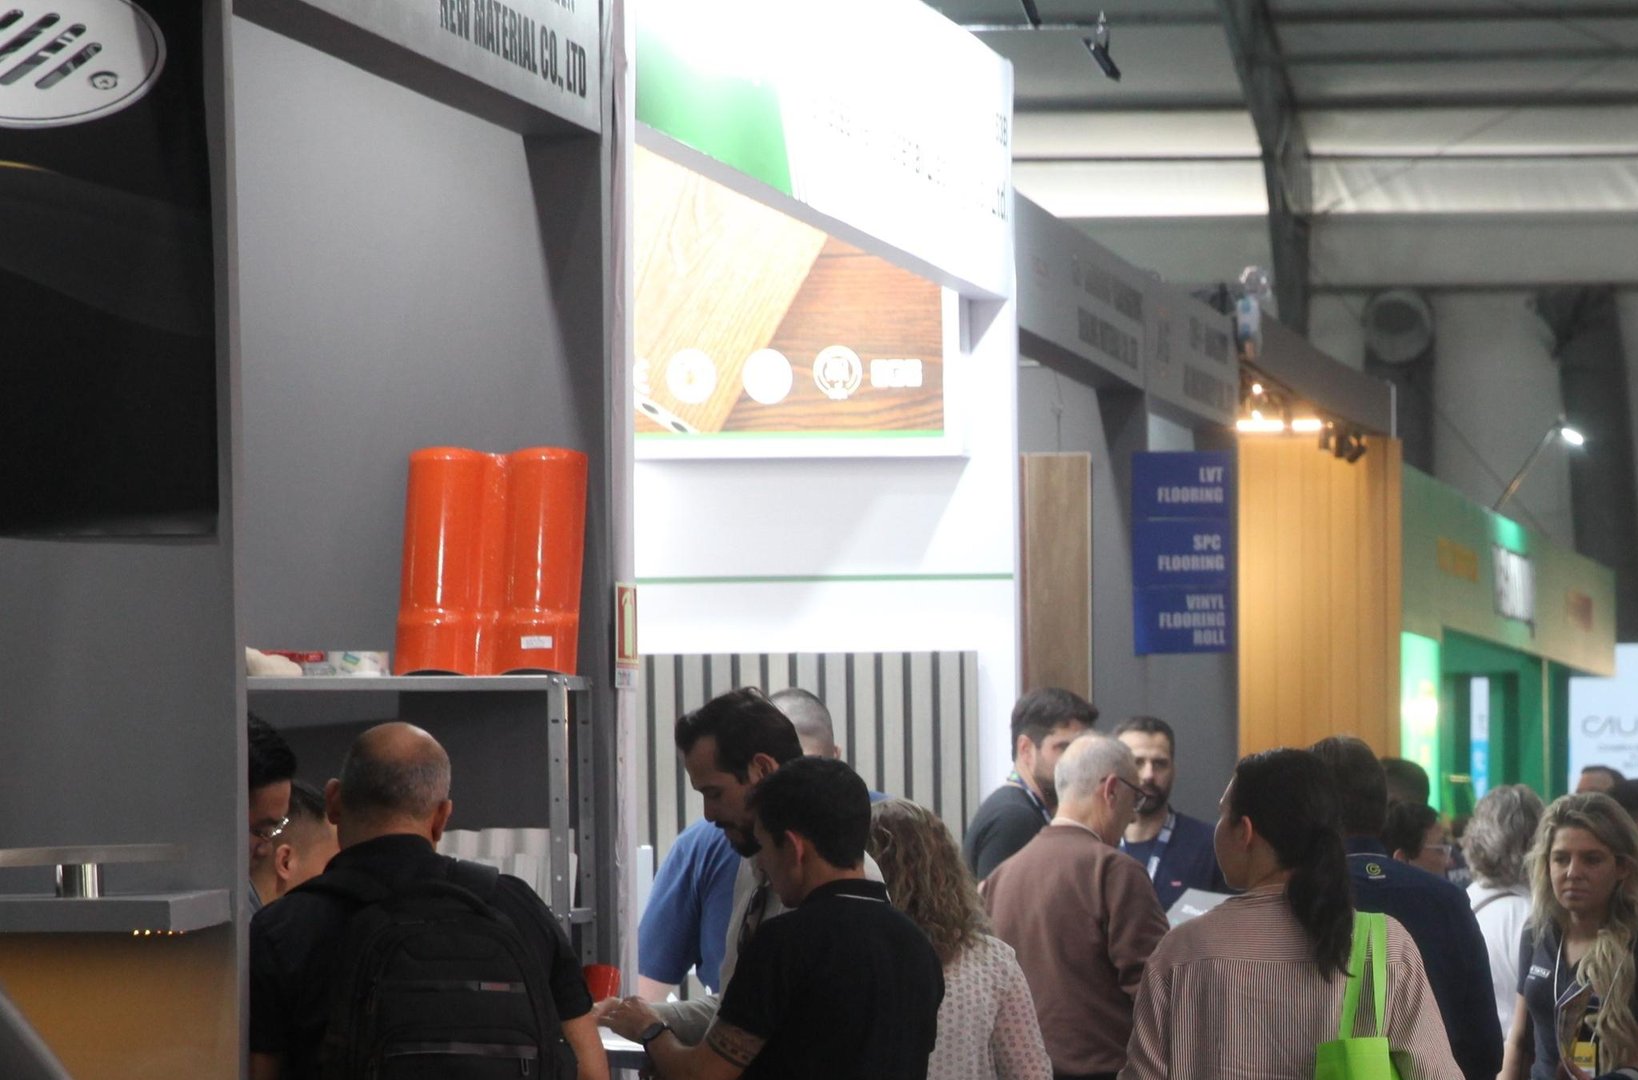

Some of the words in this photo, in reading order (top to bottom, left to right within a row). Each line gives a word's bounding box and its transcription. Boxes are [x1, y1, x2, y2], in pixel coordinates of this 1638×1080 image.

[440, 0, 470, 41] NEW
[474, 0, 538, 75] MATERIAL
[540, 25, 564, 92] CO.,
[566, 38, 586, 98] LTD
[1199, 466, 1223, 483] LVT
[1157, 487, 1224, 503] FLOORING
[1193, 534, 1221, 551] SPC
[1158, 554, 1225, 571] FLOORING
[1186, 594, 1225, 610] VINYL
[1159, 612, 1225, 629] FLOORING
[1193, 629, 1225, 646] ROLL
